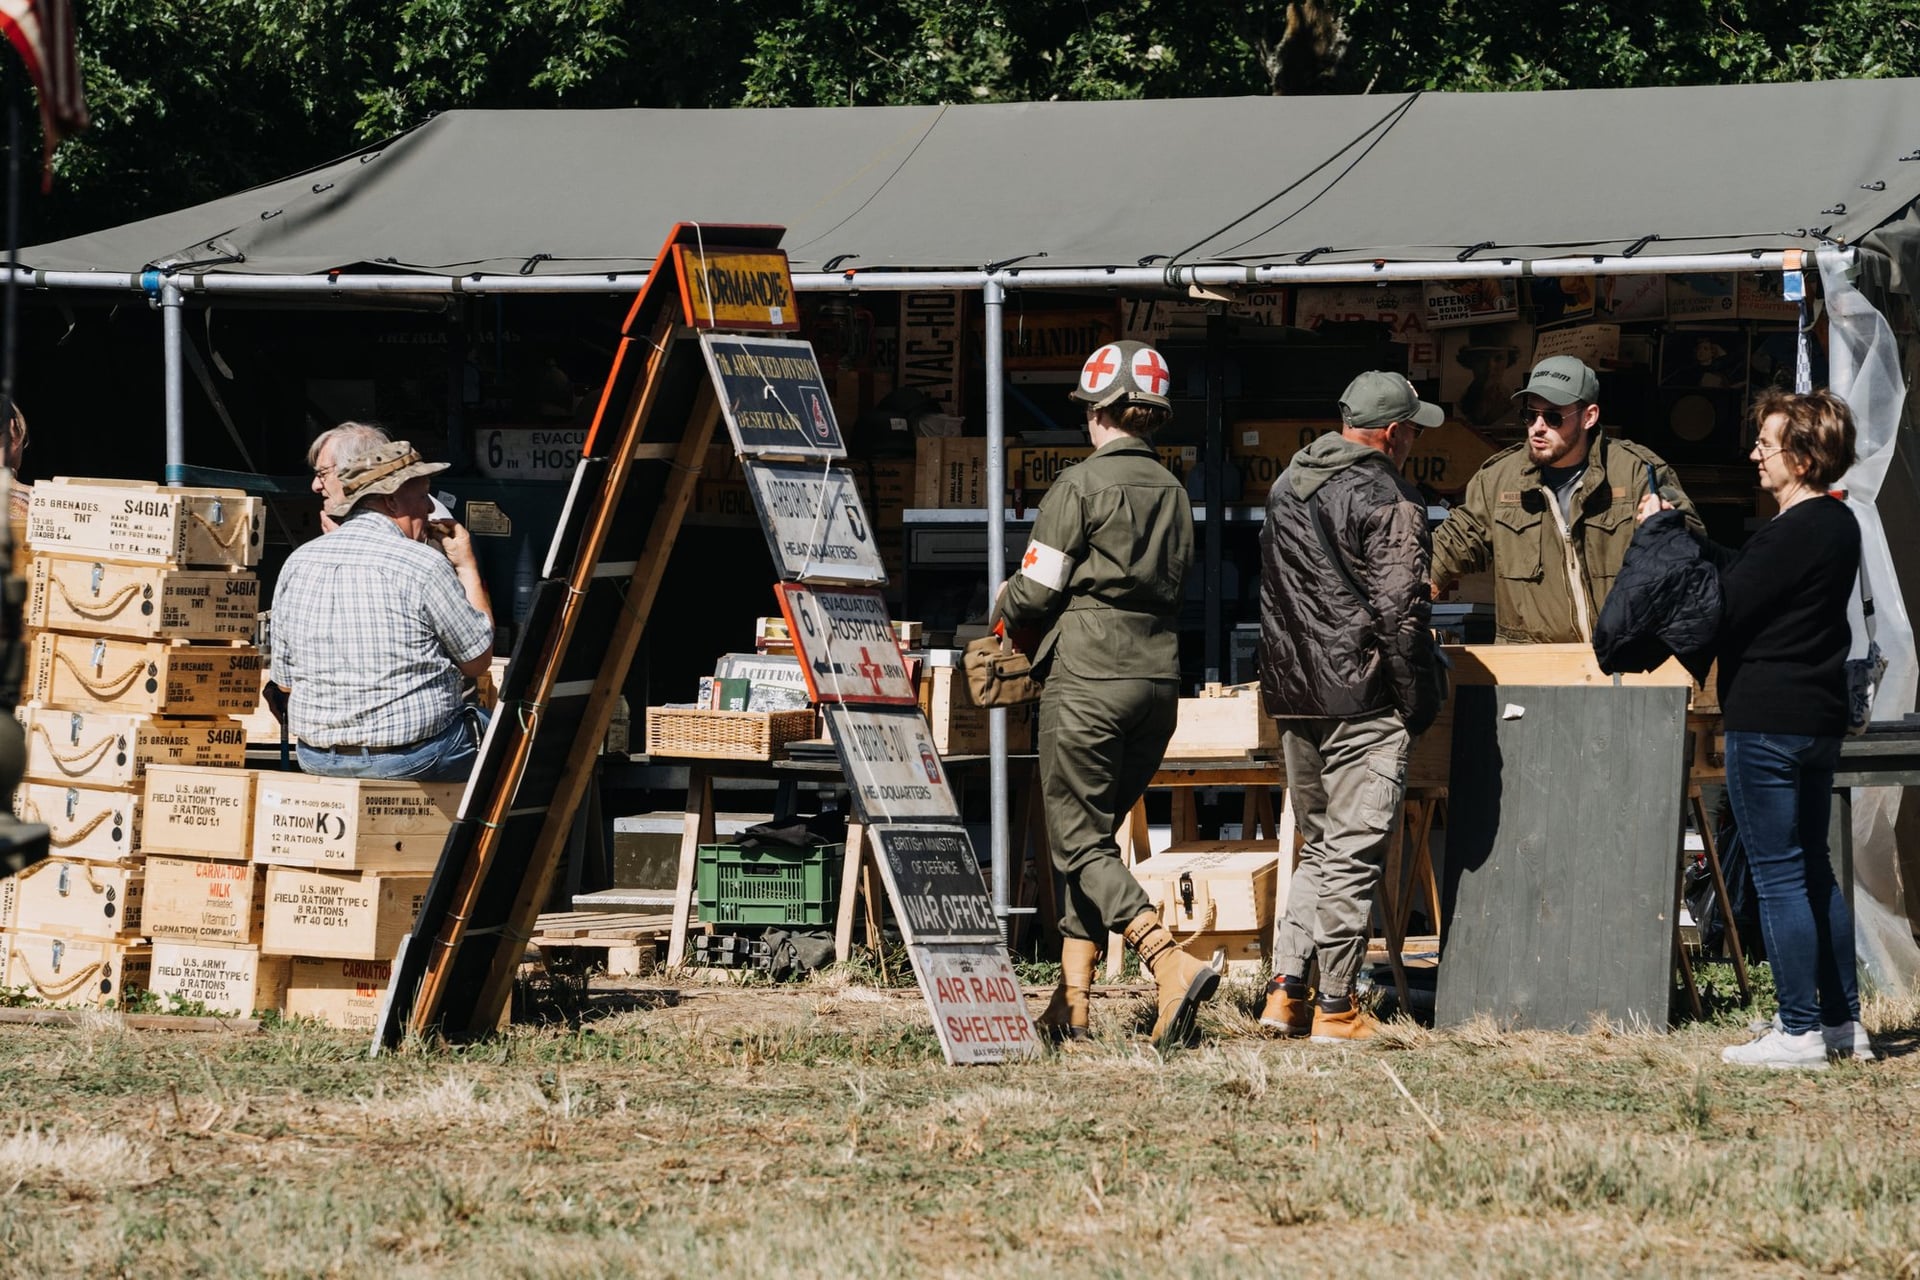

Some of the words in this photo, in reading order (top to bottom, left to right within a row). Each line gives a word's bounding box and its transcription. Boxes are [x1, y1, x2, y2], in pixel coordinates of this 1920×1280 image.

[695, 267, 788, 307] NORMANDIE
[1429, 295, 1477, 307] DEFENSE
[737, 410, 776, 430] DESERT
[34, 498, 46, 507] 25
[74, 513, 92, 524] TNT
[109, 542, 125, 551] LOT
[783, 541, 858, 560] HEADQUARTERS
[165, 587, 173, 596] 25
[191, 599, 204, 608] TNT
[796, 592, 815, 637] 6
[820, 596, 885, 614] EVACUATION
[828, 617, 892, 643] HOSPITAL
[882, 665, 905, 679] ARMY
[138, 736, 148, 745] 25
[169, 748, 183, 758] TNT
[193, 785, 217, 795] ARMY
[152, 793, 175, 803] FIELD
[176, 795, 207, 805] RATION
[209, 796, 231, 807] TYPE
[233, 799, 239, 807] C
[180, 805, 216, 816] RATIONS
[368, 806, 382, 815] NEW
[169, 814, 182, 824] WT
[183, 816, 194, 825] 40
[196, 817, 208, 826] CU
[273, 814, 315, 829] RATION
[316, 812, 329, 834] K
[272, 834, 281, 842] 12
[284, 834, 324, 845] RATIONS
[893, 837, 923, 851] BRITISH
[924, 837, 960, 852] MINISTRY
[325, 849, 335, 858] CU
[195, 863, 248, 881] CARNATION
[911, 860, 923, 874] OF
[209, 882, 231, 898] MILK
[320, 886, 344, 896] ARMY
[274, 893, 299, 904] FIELD
[302, 895, 335, 906] RATION
[338, 897, 360, 908] TYPE
[363, 899, 369, 908] C
[306, 906, 344, 917] RATIONS
[903, 895, 945, 930] WAR
[942, 895, 997, 930] OFFICE
[202, 912, 229, 926] Vitamin
[231, 914, 238, 927] D
[294, 915, 308, 924] WT
[309, 916, 320, 925] 40
[324, 917, 336, 926] CU
[153, 924, 198, 935] CARNATION
[202, 959, 227, 969] ARMY
[158, 966, 181, 977] FIELD
[184, 969, 216, 979] RATION
[219, 970, 241, 981] TYPE
[243, 973, 249, 981] C
[188, 979, 226, 990] RATIONS
[356, 982, 378, 998] MILK
[936, 977, 971, 1003] AIR
[969, 977, 1016, 1003] RAID
[176, 988, 189, 999] WT
[192, 990, 203, 999] 40
[205, 990, 217, 1000] CU
[343, 1011, 371, 1026] Vitamin
[947, 1016, 1031, 1043] SHELTER
